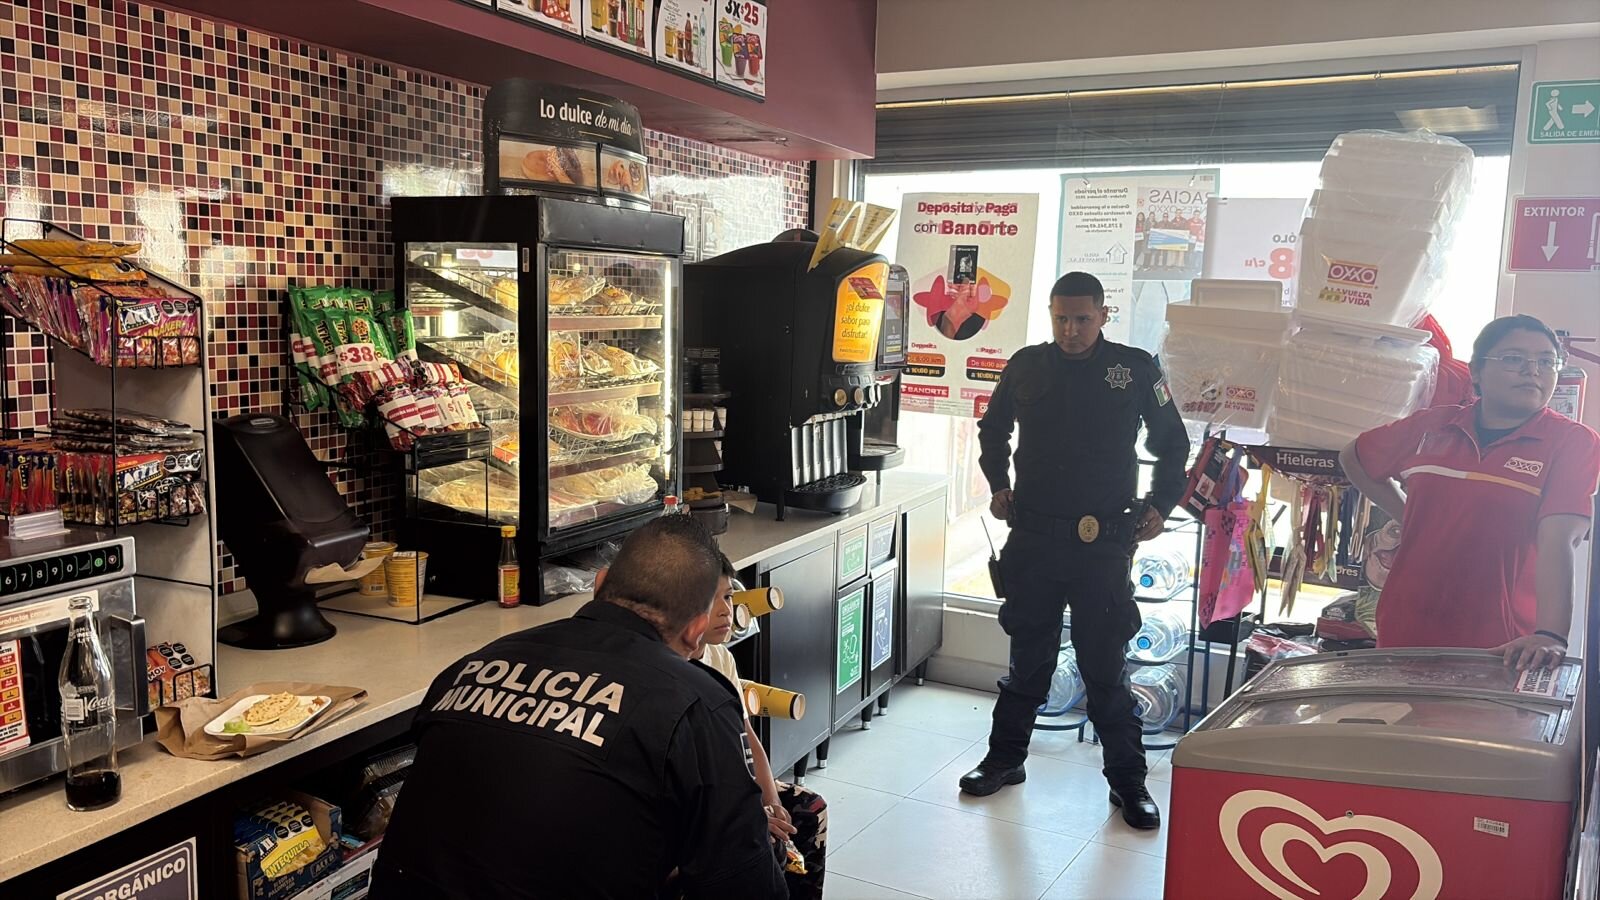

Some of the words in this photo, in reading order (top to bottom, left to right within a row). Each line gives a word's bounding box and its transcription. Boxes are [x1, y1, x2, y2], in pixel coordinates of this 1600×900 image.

[740, 2, 759, 26] $25
[540, 98, 556, 119] Lo
[559, 102, 592, 126] dulce
[594, 108, 608, 128] de
[608, 117, 619, 131] mi
[1540, 130, 1565, 138] SALIDA
[917, 202, 973, 215] Deposita
[985, 202, 1018, 216] Paga
[1524, 207, 1585, 216] EXTINTOR
[914, 223, 937, 233] con
[941, 220, 1018, 236] Banorte
[1330, 265, 1376, 283] OXXO
[1342, 288, 1372, 300] VUELTA
[1348, 296, 1370, 307] VIDA
[340, 346, 374, 364] $38
[908, 387, 948, 396] BANORTE
[1228, 388, 1254, 398] OXXO
[1276, 452, 1335, 468] Hieleras
[1508, 460, 1540, 473] OXXO
[5, 576, 11, 585] 6
[21, 573, 27, 582] 7
[37, 570, 43, 578] 8
[52, 566, 58, 575] 9
[66, 564, 73, 572] 0
[453, 659, 625, 714] POLICÍA
[431, 684, 606, 748] MUNICIPAL
